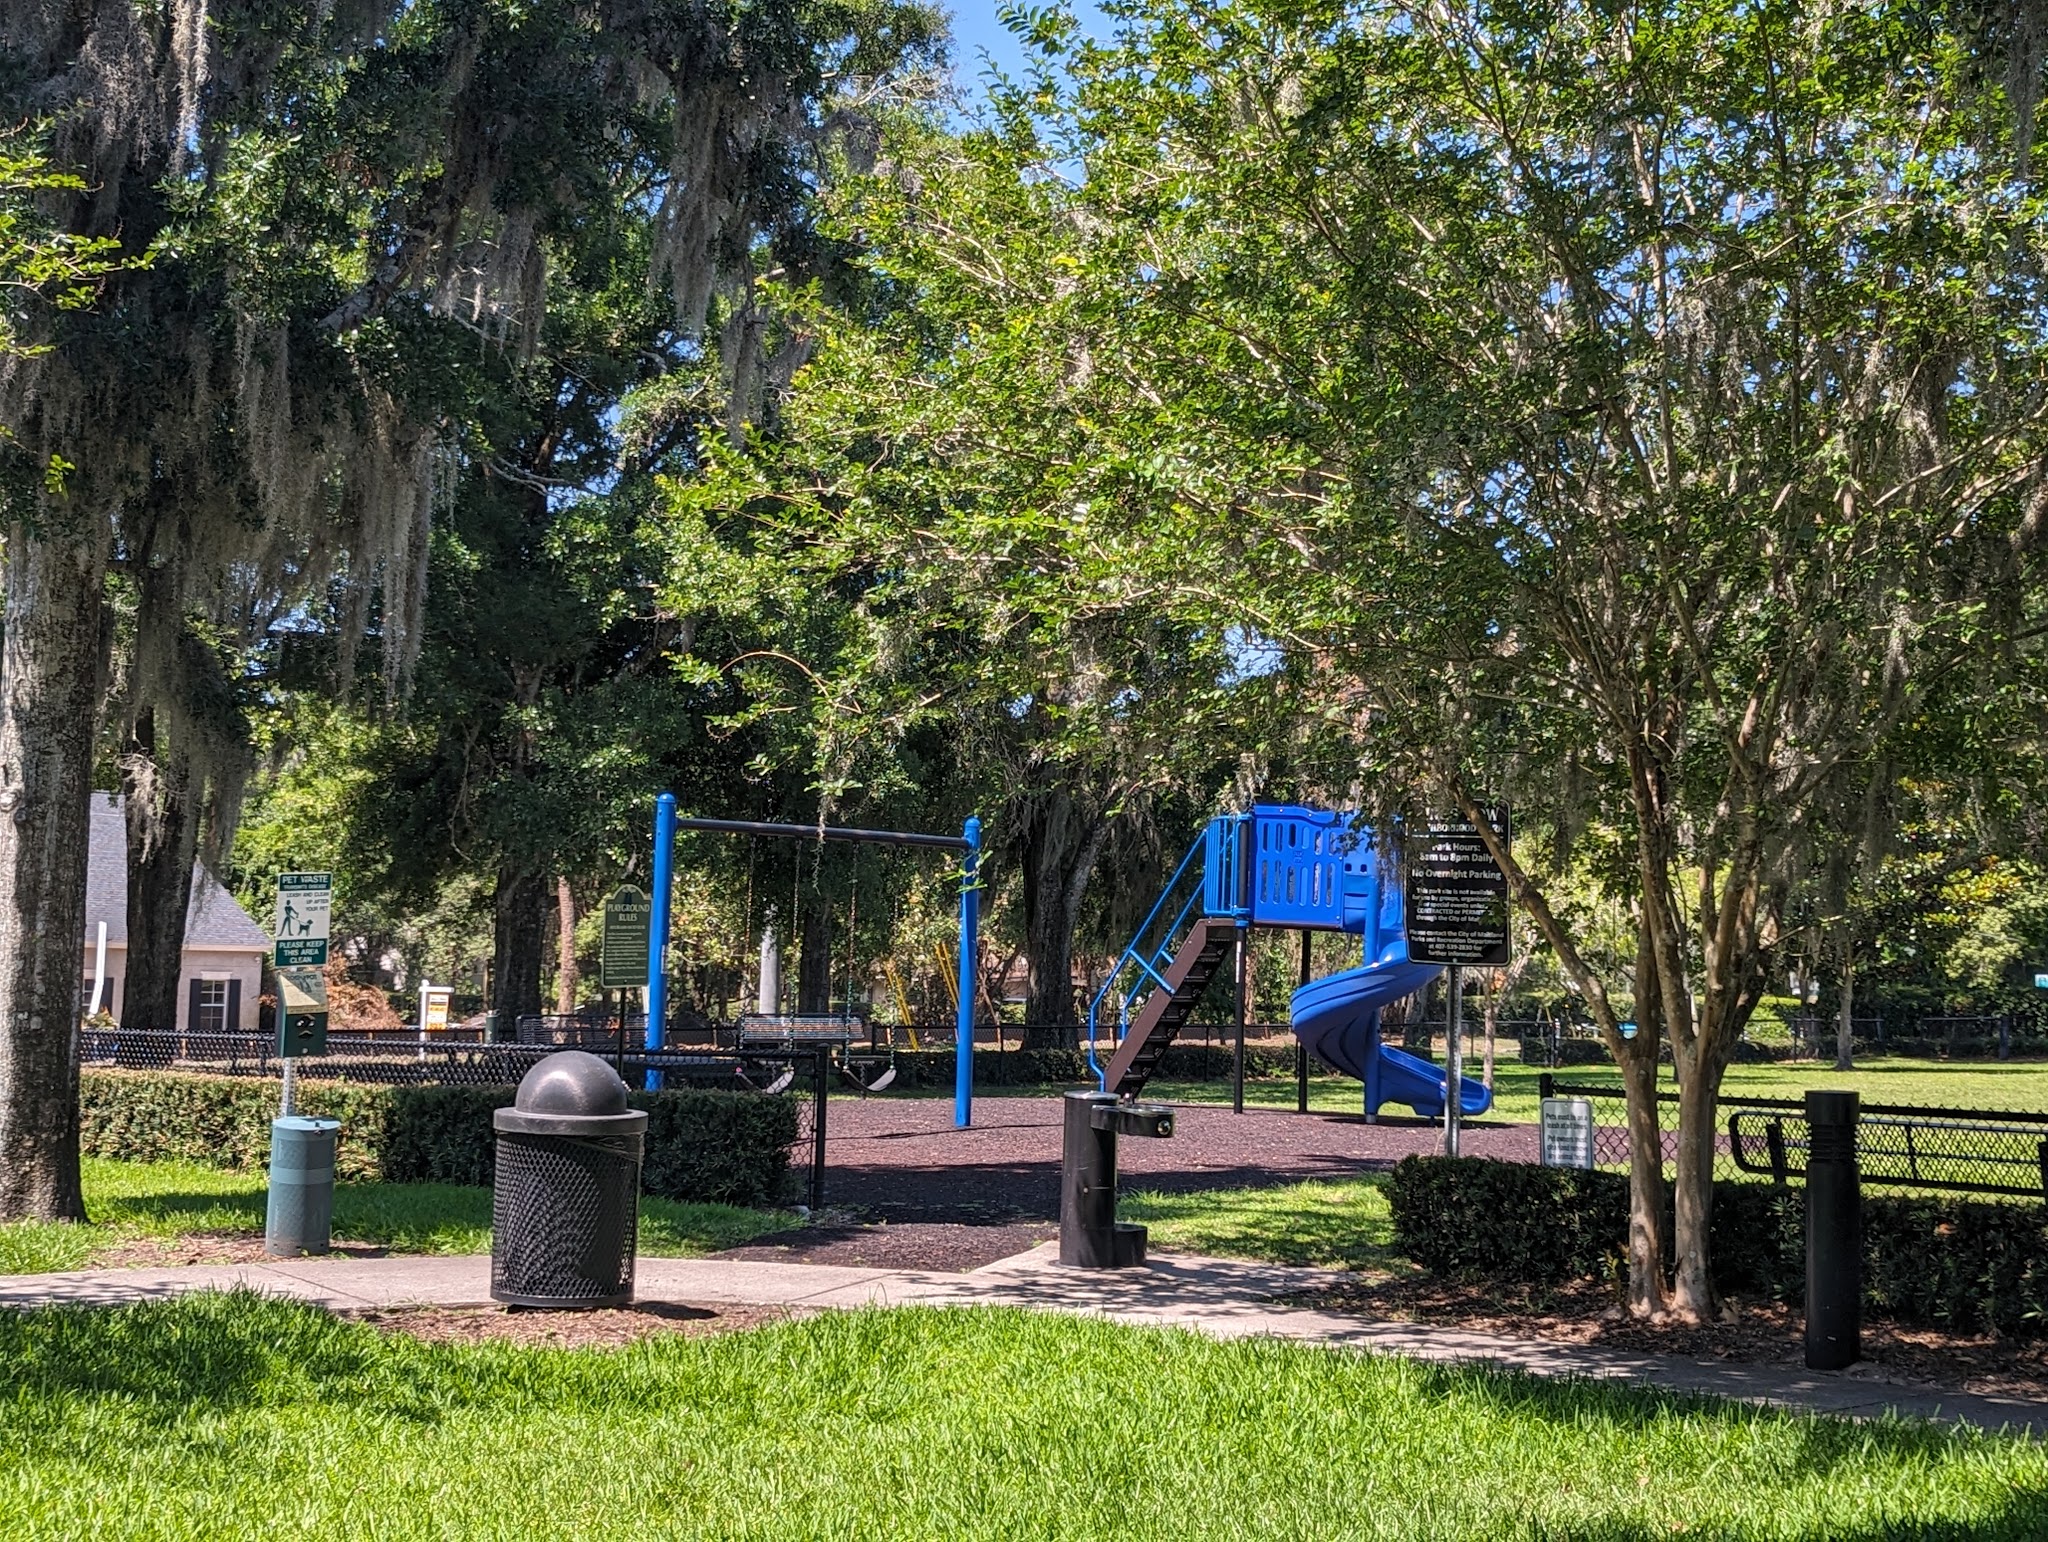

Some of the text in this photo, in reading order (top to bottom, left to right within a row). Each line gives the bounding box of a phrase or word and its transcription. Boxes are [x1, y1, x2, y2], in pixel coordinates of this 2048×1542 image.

[1452, 843, 1481, 852] Hours:
[1439, 853, 1449, 861] to
[1450, 853, 1470, 863] 8pm
[1471, 853, 1494, 863] Daily
[1411, 869, 1502, 881] No Overnight Parking
[282, 875, 329, 884] PET WASTE
[607, 904, 650, 912] PLAYGROUND
[618, 913, 638, 921] RULES
[1458, 930, 1469, 938] City
[279, 941, 304, 949] PLEASE
[289, 956, 312, 964] CLEAN
